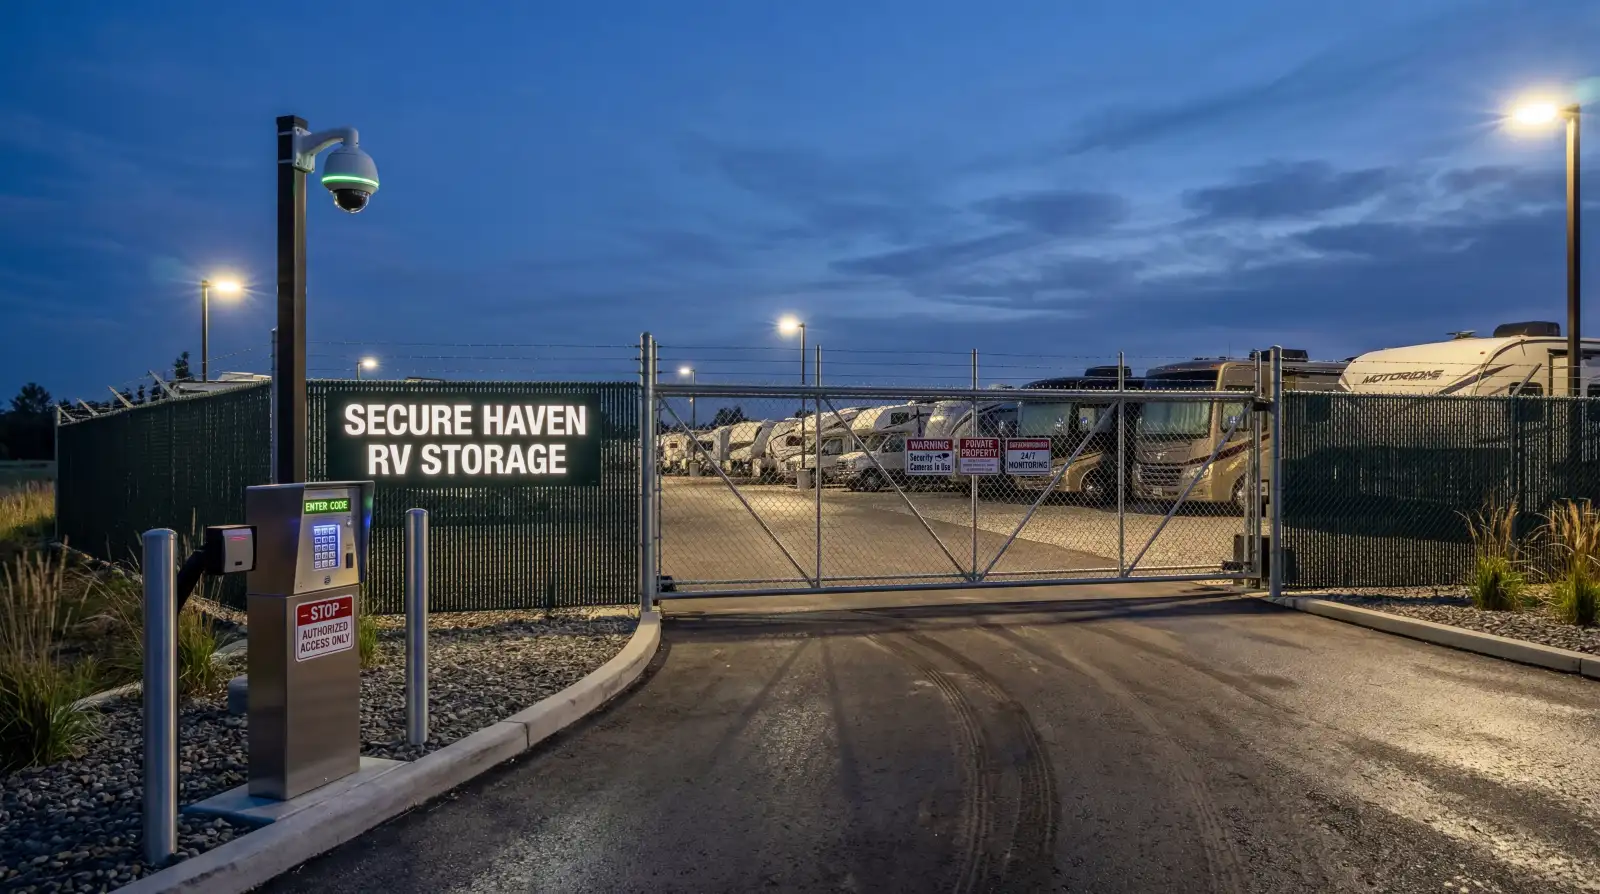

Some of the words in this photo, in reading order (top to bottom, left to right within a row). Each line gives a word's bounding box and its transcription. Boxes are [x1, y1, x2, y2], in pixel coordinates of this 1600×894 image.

[344, 404, 473, 436] SECURE
[483, 405, 586, 436] HAVEN
[910, 440, 949, 450] WARNING
[961, 449, 998, 457] PROPERTY
[1020, 452, 1036, 460] 24/7
[368, 444, 412, 475] RV
[421, 444, 567, 475] STORAGE
[1008, 461, 1048, 469] MONITORING
[910, 463, 933, 471] Cameras
[934, 462, 940, 471] In
[941, 463, 951, 471] Use
[305, 501, 328, 512] ENTER
[330, 500, 348, 510] CODE
[311, 602, 340, 621] STOP
[302, 621, 349, 640] AUTHORIZED
[300, 638, 330, 653] ACCESS
[331, 633, 350, 646] ONLY
